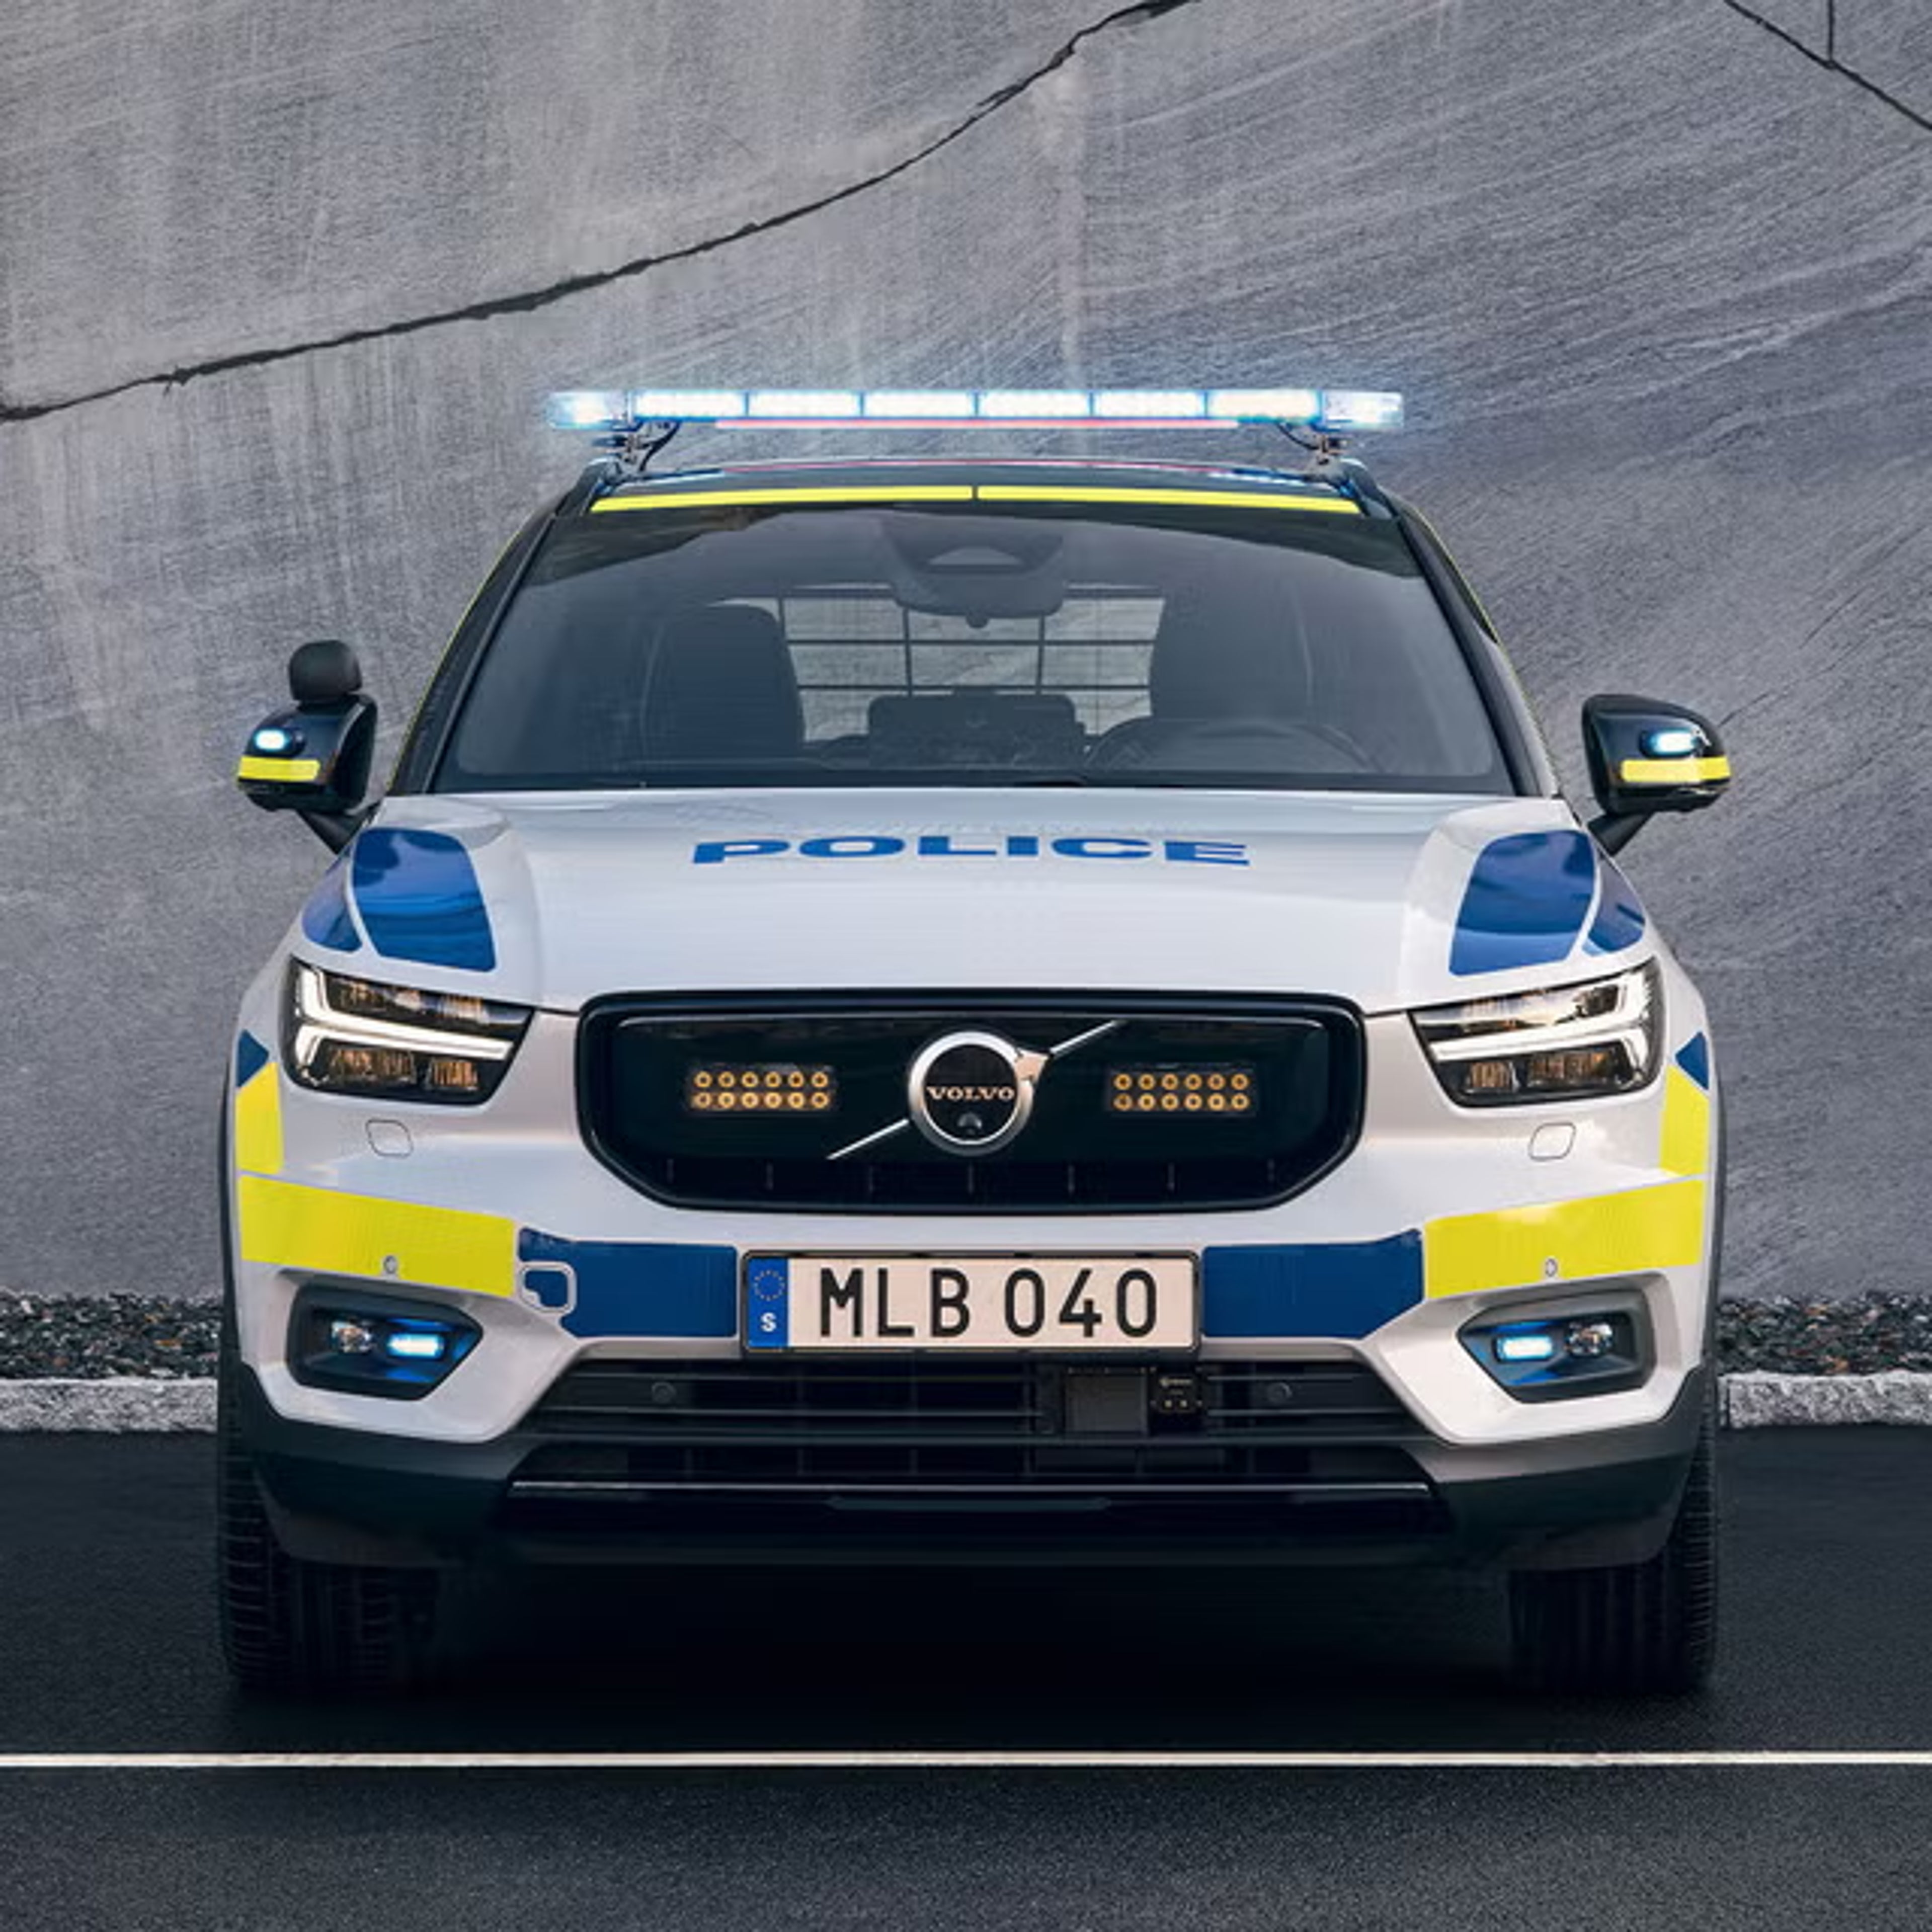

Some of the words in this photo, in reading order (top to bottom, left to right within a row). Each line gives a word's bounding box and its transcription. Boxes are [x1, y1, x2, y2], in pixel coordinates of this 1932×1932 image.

[693, 836, 1249, 865] POLICE
[926, 1086, 1015, 1100] VOLVO
[821, 1268, 970, 1337] MLB
[1005, 1268, 1157, 1337] 040
[761, 1313, 776, 1331] S
